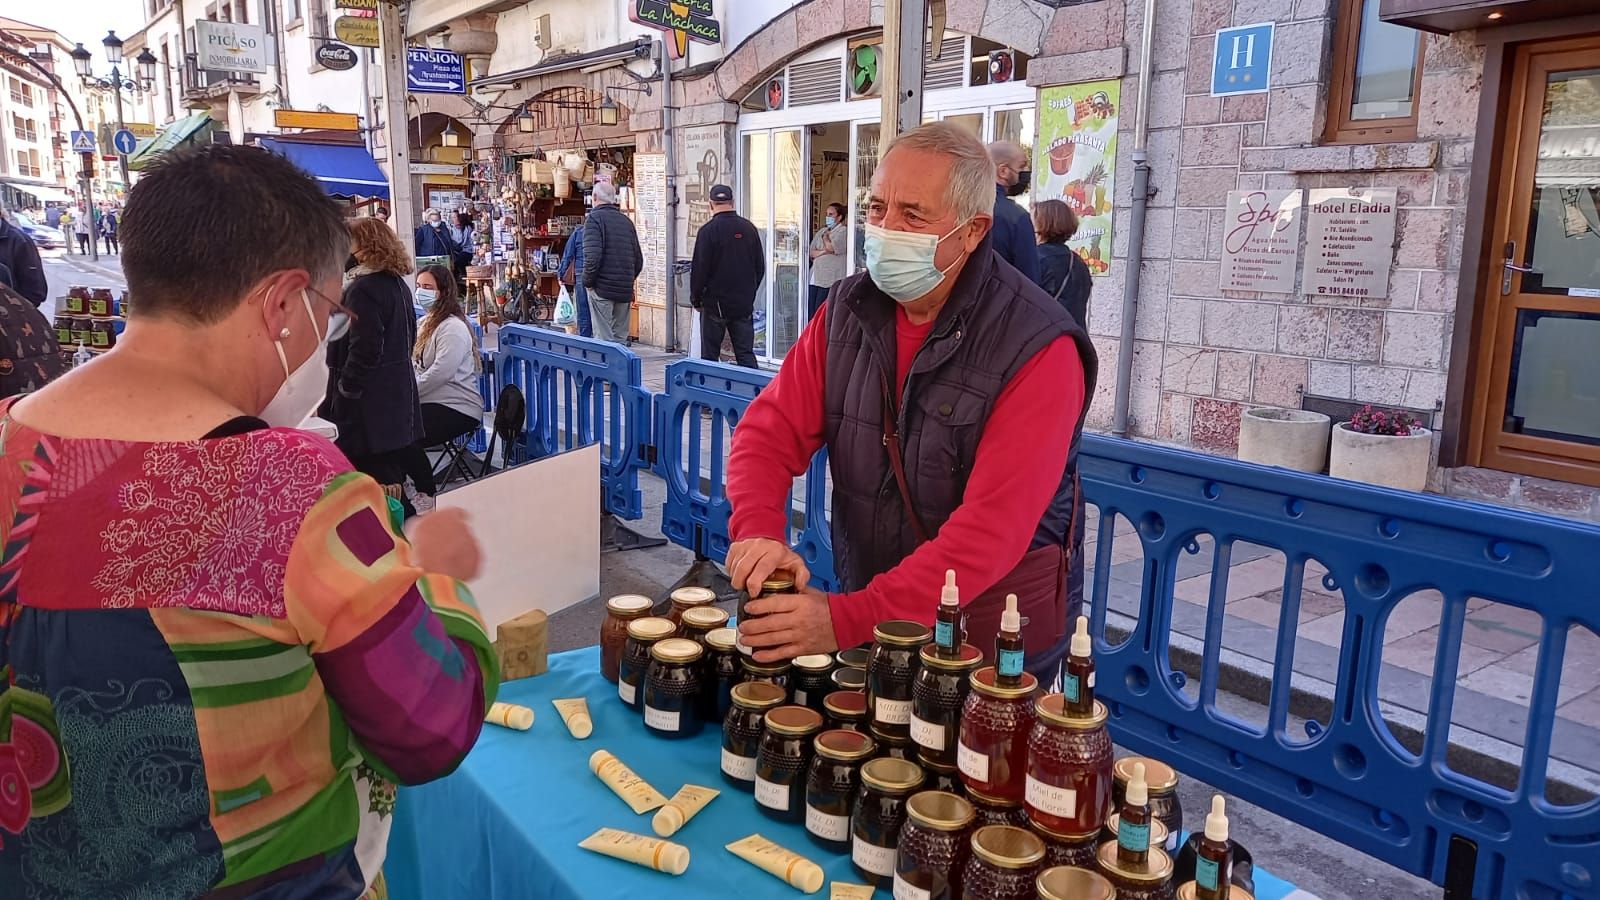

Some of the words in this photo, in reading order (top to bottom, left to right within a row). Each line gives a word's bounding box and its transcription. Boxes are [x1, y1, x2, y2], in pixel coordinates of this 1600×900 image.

[639, 0, 658, 20] La
[662, 7, 718, 38] Machaca
[319, 47, 351, 61] Coca-Cola
[1228, 33, 1257, 70] H
[209, 54, 258, 67] INMOBILIARIA
[433, 64, 451, 72] Plaza
[451, 65, 461, 73] del
[1313, 202, 1345, 214] Hotel
[1349, 202, 1391, 214] Eladia
[1252, 237, 1269, 245] Agua
[1271, 247, 1296, 256] Europa
[1328, 286, 1340, 294] 985
[1355, 288, 1369, 296] 000
[1032, 782, 1050, 799] Miel
[1050, 790, 1065, 802] de
[1040, 799, 1069, 816] flores
